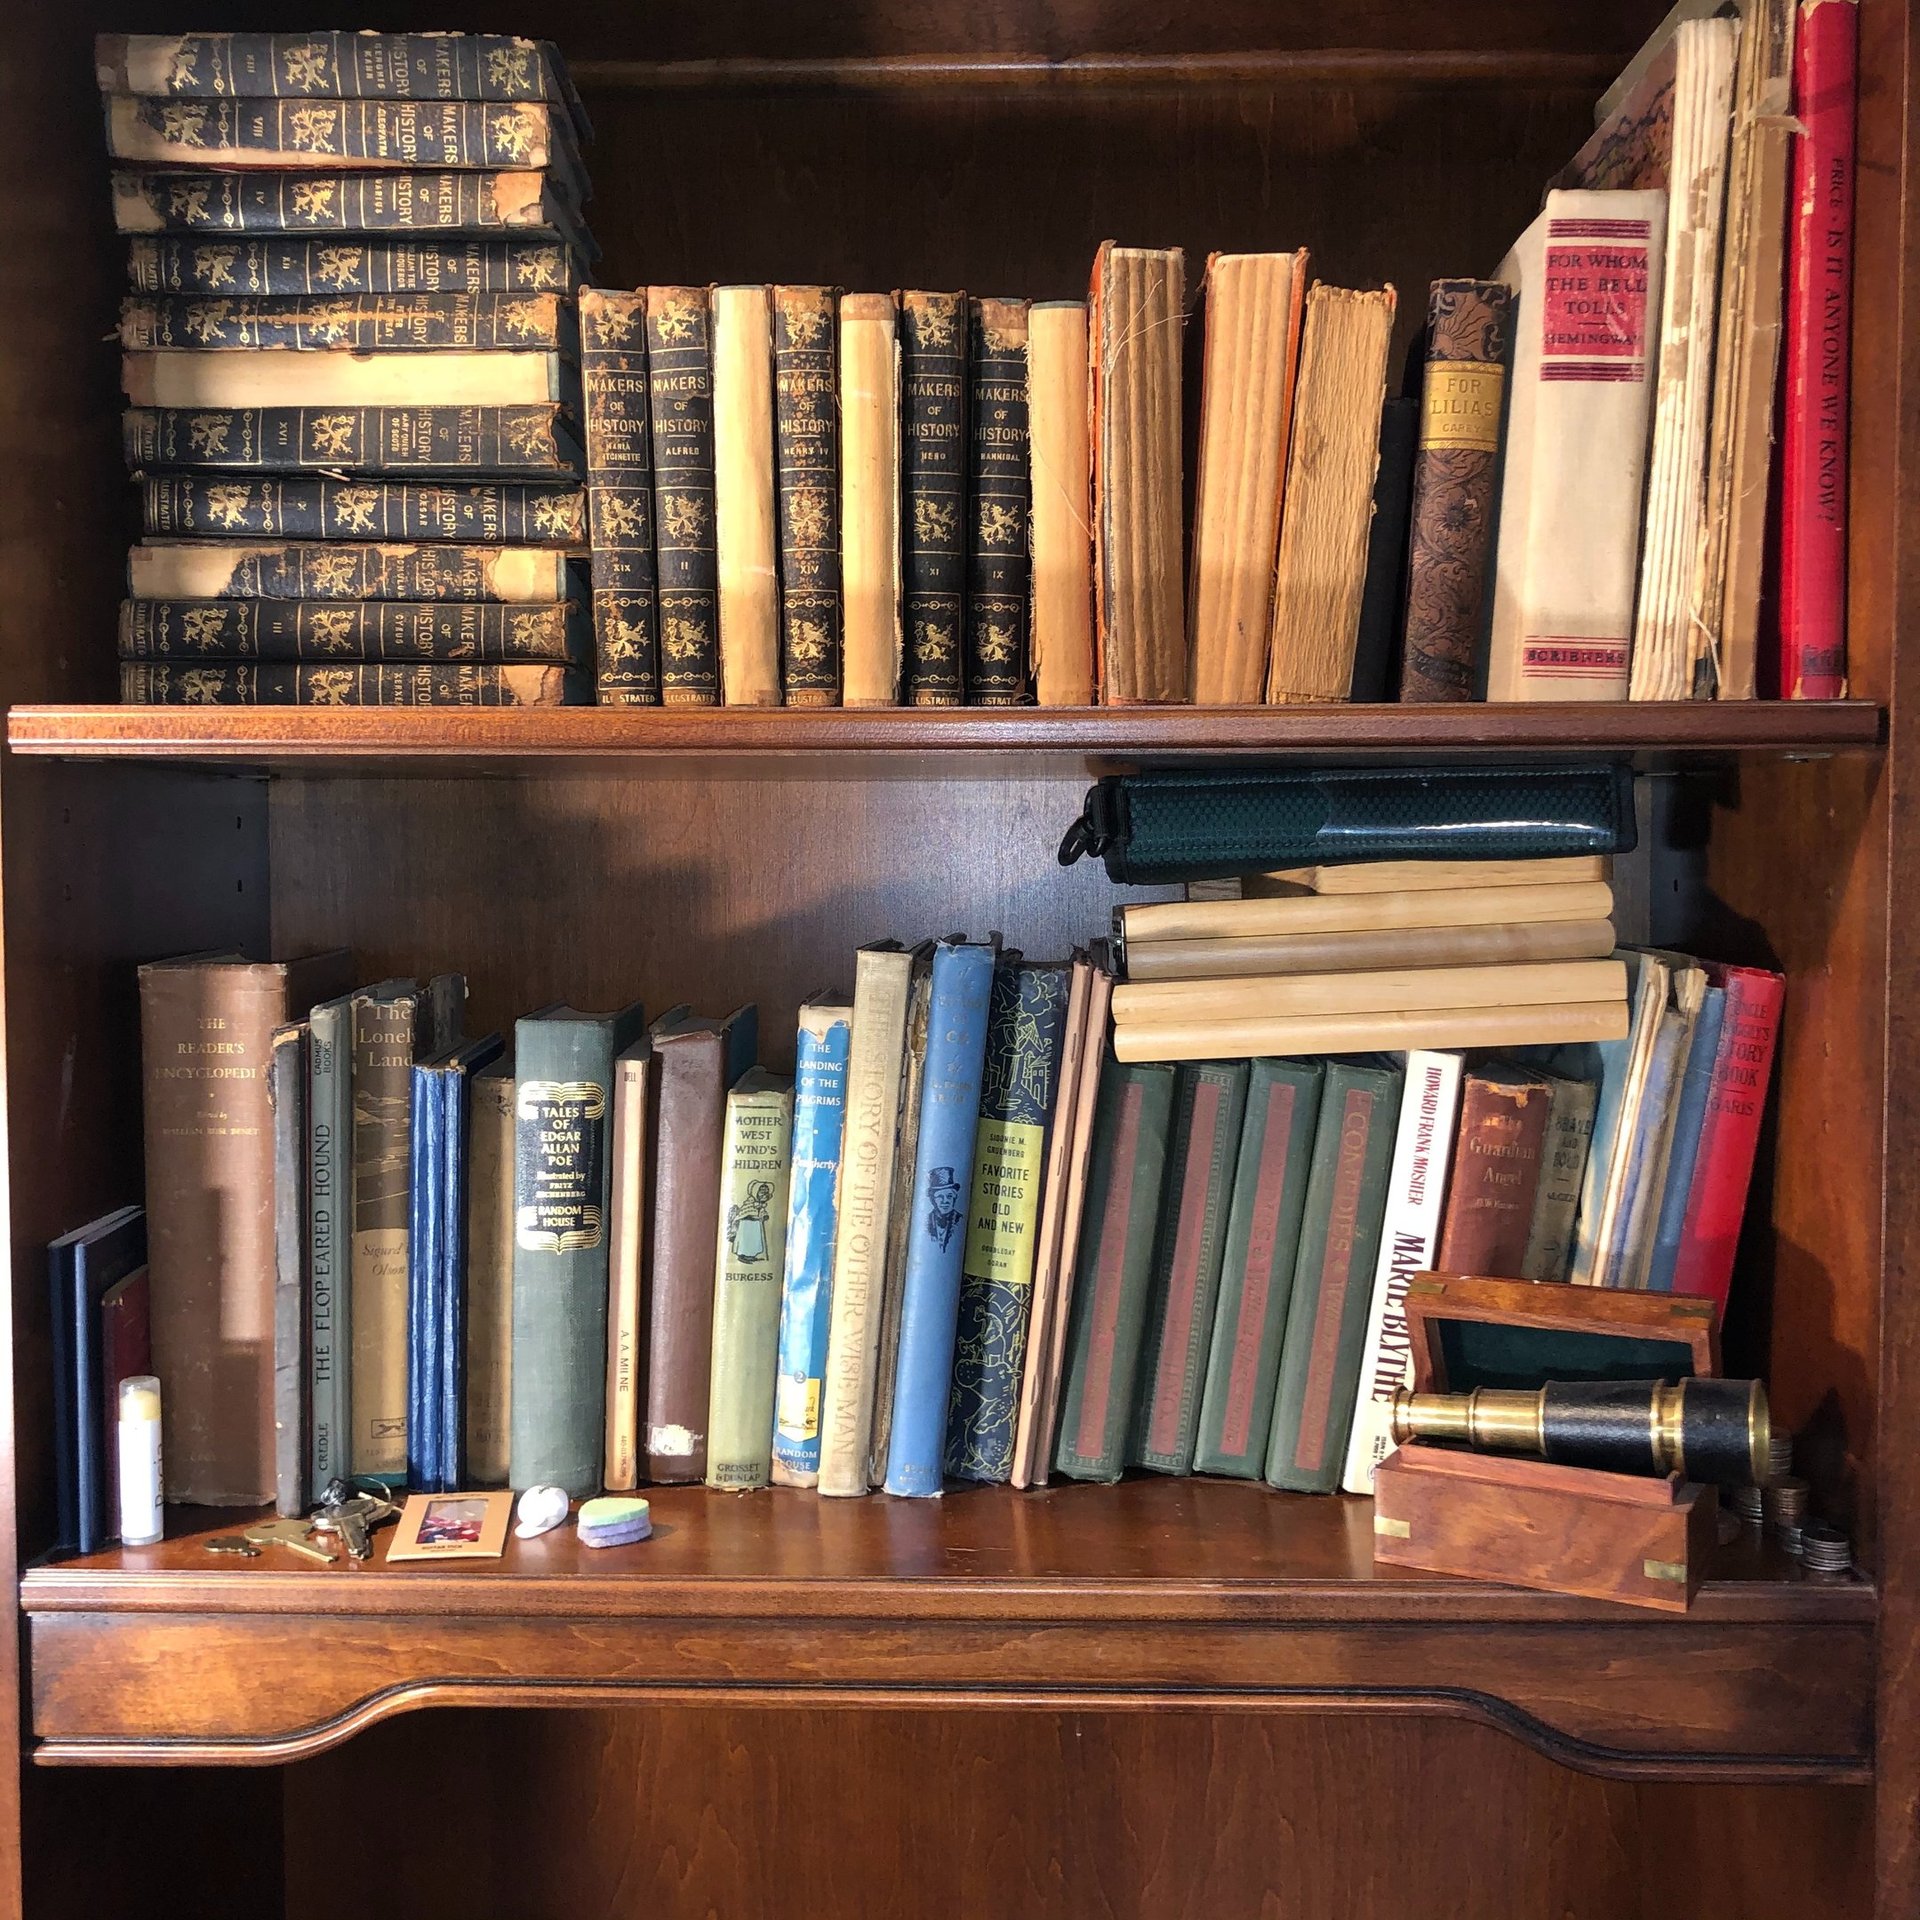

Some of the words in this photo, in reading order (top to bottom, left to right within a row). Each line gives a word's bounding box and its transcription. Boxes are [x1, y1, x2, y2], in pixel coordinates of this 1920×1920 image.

[393, 35, 410, 98] HISTORY
[417, 59, 427, 75] OF
[436, 38, 451, 98] MAKERS
[252, 116, 264, 138] VIII
[377, 109, 388, 157] CLEOPATRA
[402, 103, 417, 163] HISTORY
[424, 125, 433, 142] OF
[442, 104, 458, 165] MAKERS
[256, 191, 264, 205] IV
[375, 179, 383, 214] DARIUS
[419, 188, 430, 203] OF
[1826, 230, 1846, 255] IS
[447, 259, 457, 273] OF
[467, 243, 481, 294] MAKERS
[1548, 254, 1583, 269] FOR
[1588, 255, 1648, 271] WHOM
[1826, 256, 1846, 277] IT
[408, 273, 416, 288] THE
[1547, 278, 1589, 292] THE
[1599, 279, 1648, 293] BELL
[1565, 301, 1627, 315] TOLLS
[435, 310, 445, 324] OF
[454, 295, 470, 344] MAKERS
[1822, 288, 1844, 386] ANYONE
[588, 379, 645, 394] MAKERS
[653, 376, 707, 392] MAKERS
[779, 379, 833, 393] MAKERS
[908, 383, 960, 397] MAKERS
[1447, 378, 1481, 394] FOR
[975, 387, 1027, 402] MAKERS
[609, 401, 625, 412] OF
[673, 401, 689, 412] OF
[799, 401, 814, 411] OF
[927, 406, 942, 416] OF
[1432, 400, 1494, 417] LILIAS
[1820, 394, 1840, 430] WE
[391, 417, 400, 428] OF
[402, 412, 410, 432] MARY
[994, 410, 1009, 420] OF
[279, 421, 288, 446] XVII
[589, 419, 645, 434] HISTORY
[655, 419, 708, 434] HISTORY
[780, 419, 833, 434] HISTORY
[907, 424, 960, 438] HISTORY
[390, 429, 400, 452] SCOTS
[418, 409, 432, 462] HISTORY
[438, 427, 449, 442] OF
[974, 427, 1026, 442] HISTORY
[401, 433, 409, 457] QUEEN
[665, 447, 700, 456] ALFRED
[784, 447, 814, 456] HENRY
[820, 447, 830, 456] IV
[980, 452, 1021, 462] HANNIBAL
[1817, 439, 1839, 522] KNOW?
[297, 502, 307, 512] X
[463, 504, 474, 520] OF
[483, 487, 498, 540] MAKERS
[421, 550, 436, 597] HISTOR
[461, 550, 477, 597] MAKER
[612, 563, 631, 573] XIX
[681, 561, 690, 571] II
[800, 564, 819, 575] XIV
[930, 568, 940, 576] XI
[442, 569, 454, 583] OF
[992, 571, 1004, 579] IX
[272, 621, 282, 634] III
[394, 614, 405, 645] CYRUS
[418, 606, 434, 657] HISTORY
[441, 624, 452, 639] OF
[1527, 650, 1627, 664] SCRIBNERS
[274, 685, 283, 693] V
[811, 1042, 832, 1054] THE
[314, 1038, 323, 1076] CADMUS
[323, 1041, 332, 1074] BOOKS
[368, 1050, 413, 1067] Land
[799, 1060, 843, 1073] LANDING
[801, 1077, 815, 1089] OF
[818, 1077, 839, 1089] THE
[858, 1049, 888, 1137] STORY
[1420, 1066, 1443, 1116] HOWARD
[796, 1093, 842, 1107] PILGRIMS
[543, 1106, 580, 1118] TALES
[552, 1119, 571, 1130] OF
[735, 1116, 783, 1128] MOTHER
[540, 1131, 582, 1142] EDGAR
[740, 1130, 773, 1141] WEST
[989, 1133, 1016, 1145] SIDONIE
[1018, 1137, 1026, 1146] M.
[1414, 1115, 1435, 1155] FRANK
[541, 1142, 580, 1154] ALLAN
[735, 1144, 778, 1156] WIND'S
[314, 1124, 331, 1197] HOUND
[548, 1155, 573, 1167] POE
[733, 1159, 783, 1171] HILDREN
[856, 1141, 879, 1174] OF
[575, 1172, 586, 1182] by
[982, 1163, 1030, 1181] FAVORITE
[1483, 1166, 1523, 1186] Angel
[1407, 1155, 1430, 1207] MOSHER
[982, 1182, 1025, 1200] STORIES
[538, 1205, 582, 1216] RANDOM
[849, 1180, 877, 1228] THE
[991, 1202, 1011, 1216] OLD
[543, 1217, 576, 1227] HOUSE
[977, 1216, 997, 1231] AND
[1001, 1220, 1025, 1235] NEW
[362, 1242, 404, 1258] Sigurd
[372, 1263, 406, 1276] Olson
[725, 1272, 774, 1282] BURGESS
[1385, 1230, 1427, 1309] MARIE
[843, 1233, 871, 1322] OTHER
[837, 1326, 865, 1390] WISE
[1371, 1312, 1411, 1404] BLYTHE
[315, 1346, 331, 1386] THE
[832, 1400, 859, 1458] MAN
[318, 1423, 330, 1473] CREDLE
[717, 1463, 760, 1473] GROSSET
